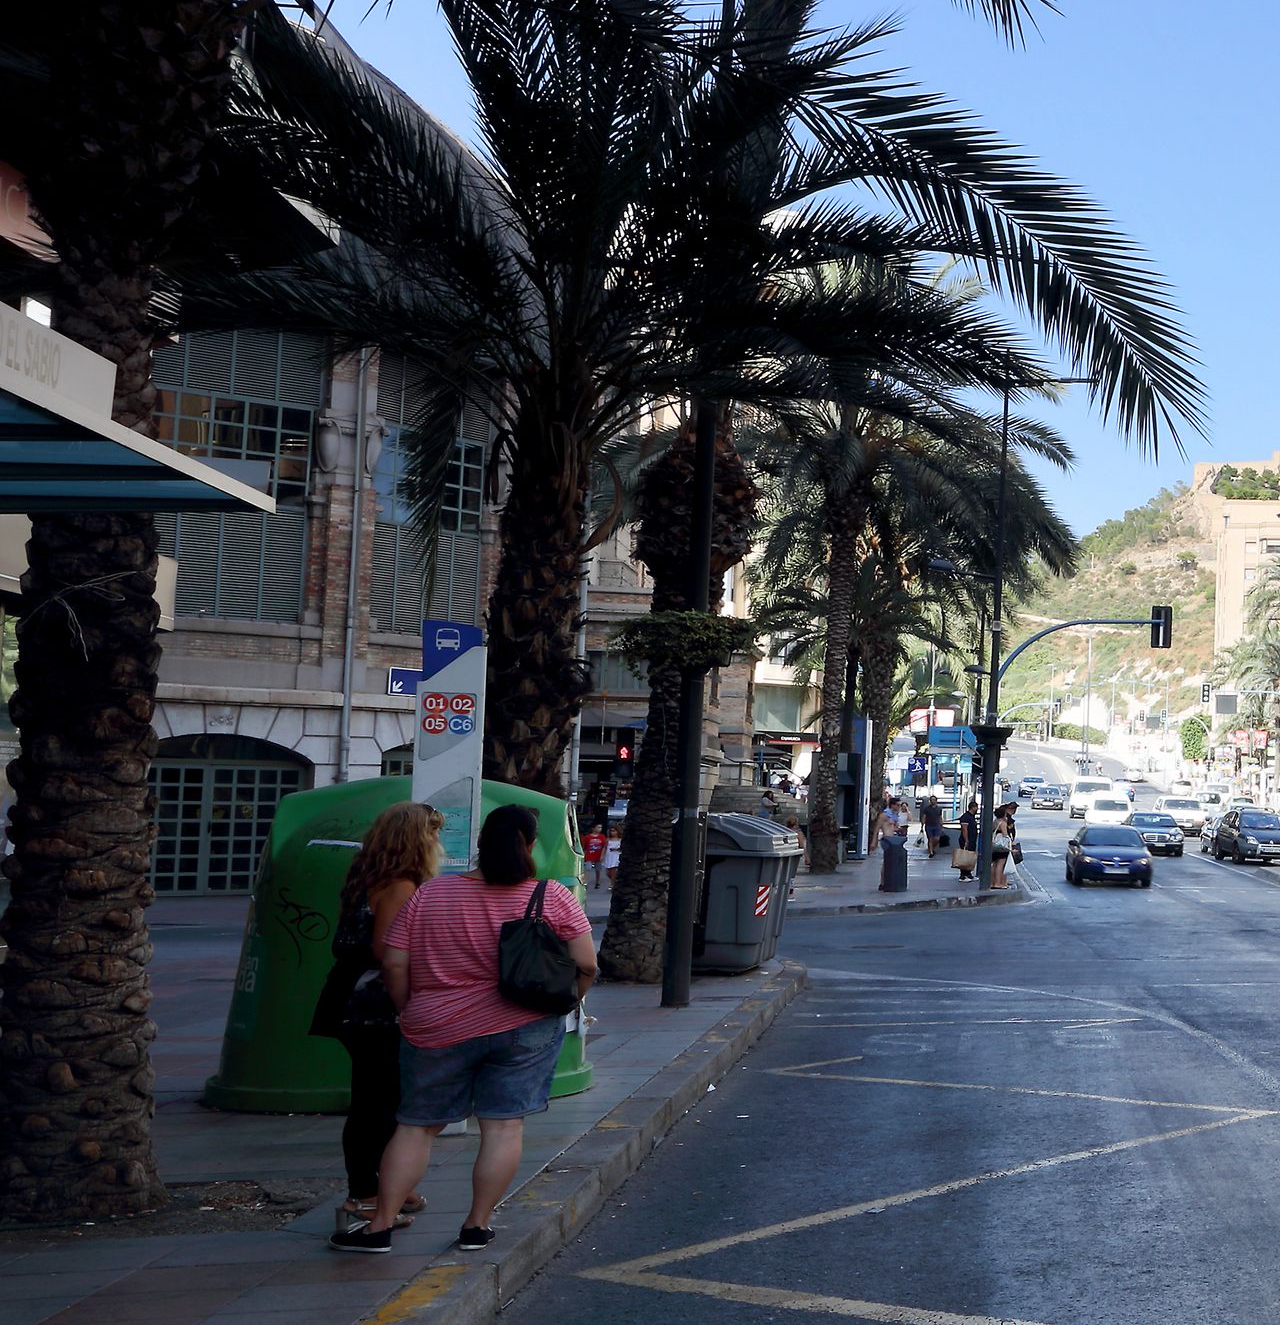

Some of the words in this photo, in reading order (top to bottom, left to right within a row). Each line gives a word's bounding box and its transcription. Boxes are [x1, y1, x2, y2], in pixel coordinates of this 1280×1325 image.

[5, 319, 20, 371] EL
[24, 330, 61, 389] SABIO
[426, 697, 445, 710] 01
[452, 698, 472, 711] 02
[425, 717, 445, 730] 05
[450, 718, 472, 731] C6
